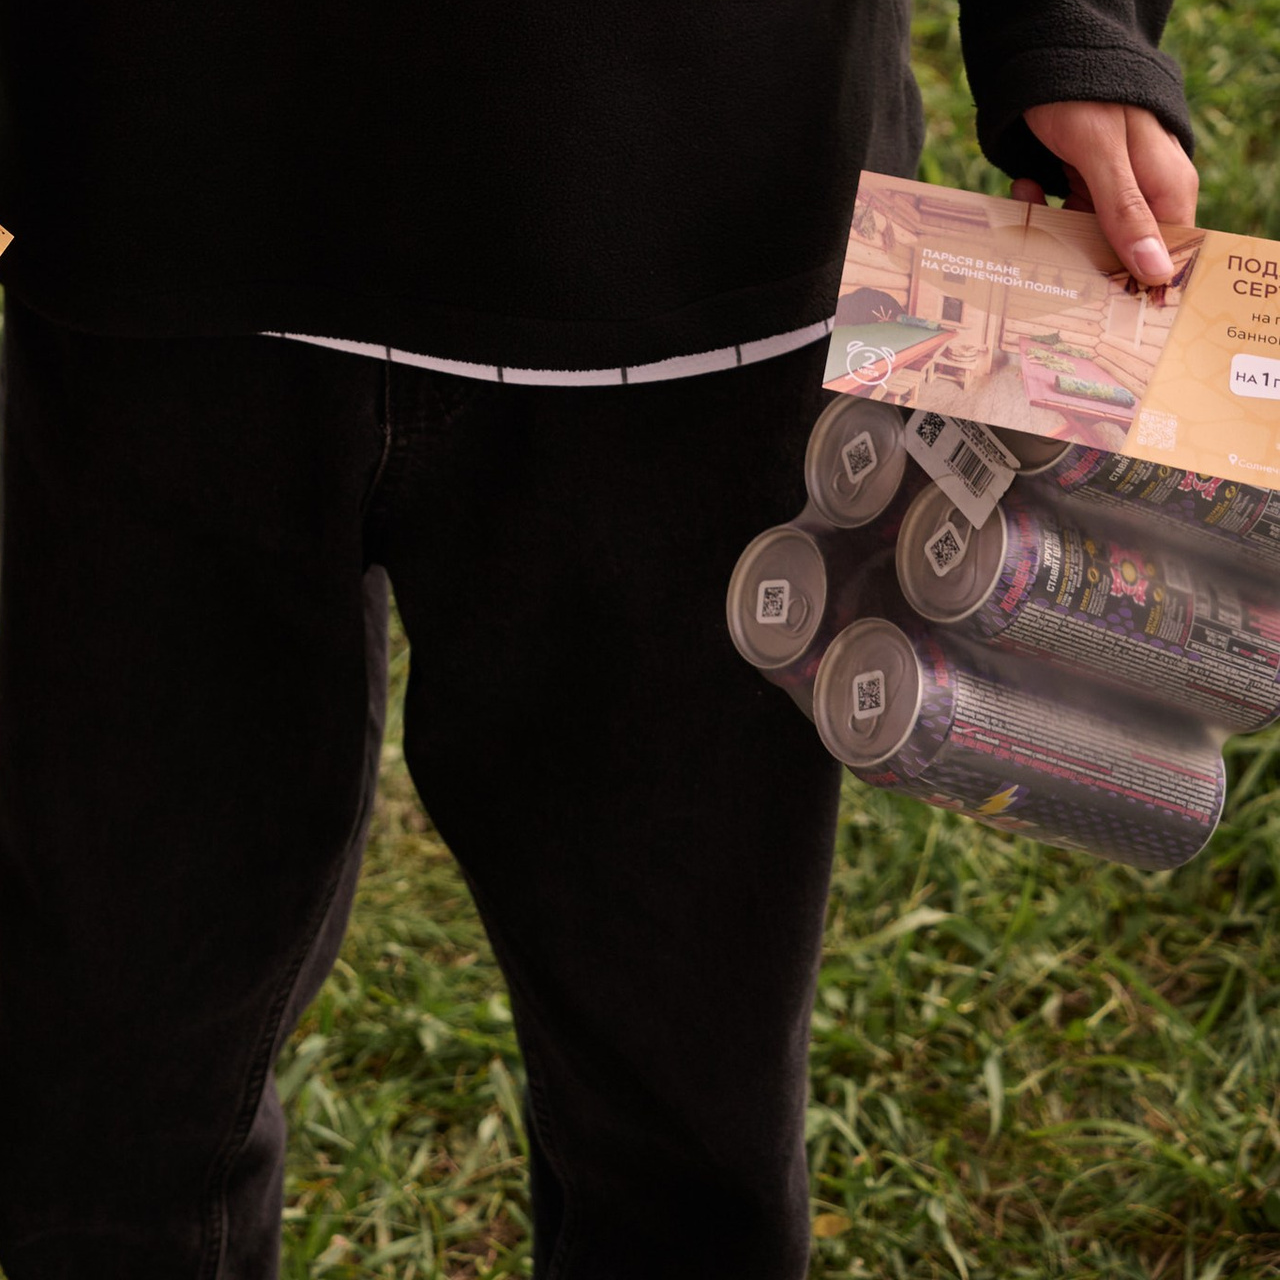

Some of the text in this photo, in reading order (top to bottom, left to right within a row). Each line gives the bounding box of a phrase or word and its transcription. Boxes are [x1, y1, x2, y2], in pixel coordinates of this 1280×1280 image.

[922, 248, 1021, 277] ПАРЬСЯ В БАНЕ
[1228, 255, 1280, 280] ПОД
[921, 258, 1079, 300] НА СОЛНЕЧНОЙ ПОЛЯНЕ
[1233, 279, 1280, 299] СЕР
[1252, 313, 1271, 324] на
[1227, 326, 1280, 346] банно
[862, 352, 876, 369] 2
[1235, 371, 1258, 385] НА
[1262, 372, 1269, 387] 1
[1046, 559, 1061, 593] СТАВЯТ
